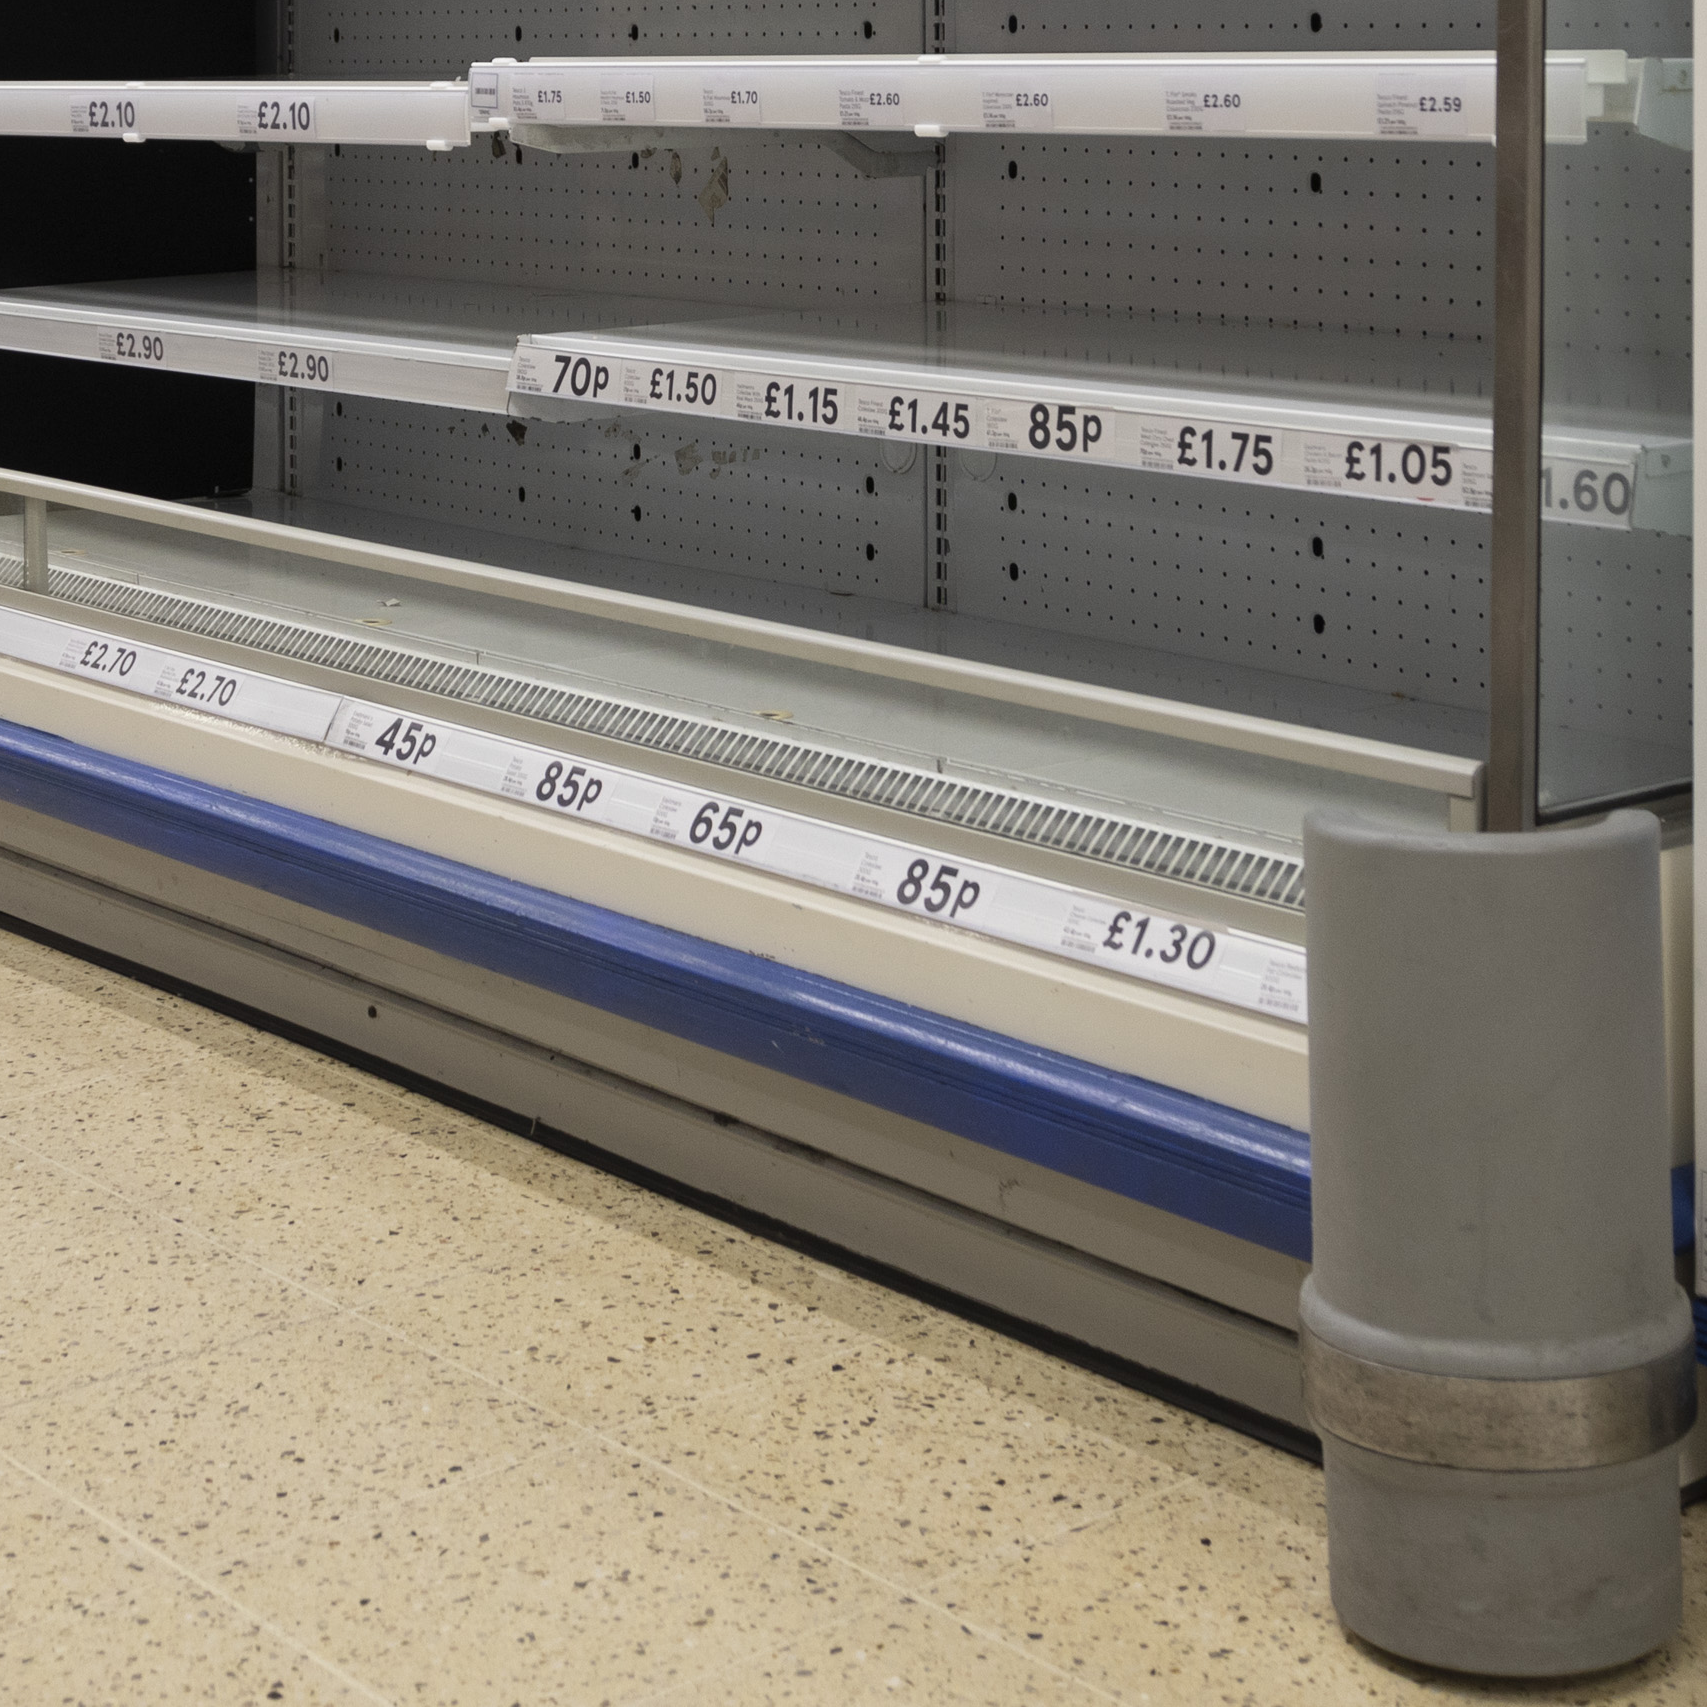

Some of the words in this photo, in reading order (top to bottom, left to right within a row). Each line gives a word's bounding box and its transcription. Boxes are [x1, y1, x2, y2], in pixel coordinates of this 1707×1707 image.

[89, 100, 135, 130] £2.10
[257, 101, 312, 132] £2.10
[537, 90, 563, 104] £1.75
[625, 91, 652, 105] £1.50
[730, 91, 758, 105] £1.70
[869, 92, 901, 107] £2.60
[1015, 93, 1050, 107] £2.60
[1203, 93, 1241, 109] £2.60
[1419, 95, 1463, 113] £2.59
[116, 330, 165, 361] £2.90
[277, 349, 330, 384] £2.90
[551, 355, 610, 400] 70p
[649, 367, 718, 407] £1.50
[764, 381, 840, 427] £1.15
[888, 395, 971, 440] £1.45
[1027, 403, 1103, 453] 85p
[1177, 425, 1275, 477] £1.75
[1344, 440, 1454, 488] £1.05
[1541, 465, 1632, 517] 1.60
[78, 638, 139, 679] £2.70
[175, 665, 237, 709] £2.70
[374, 716, 438, 764] 45p
[534, 759, 604, 813] 85p
[688, 799, 763, 857] 65p
[895, 857, 981, 920] 85p
[1101, 909, 1217, 972] £1.30
